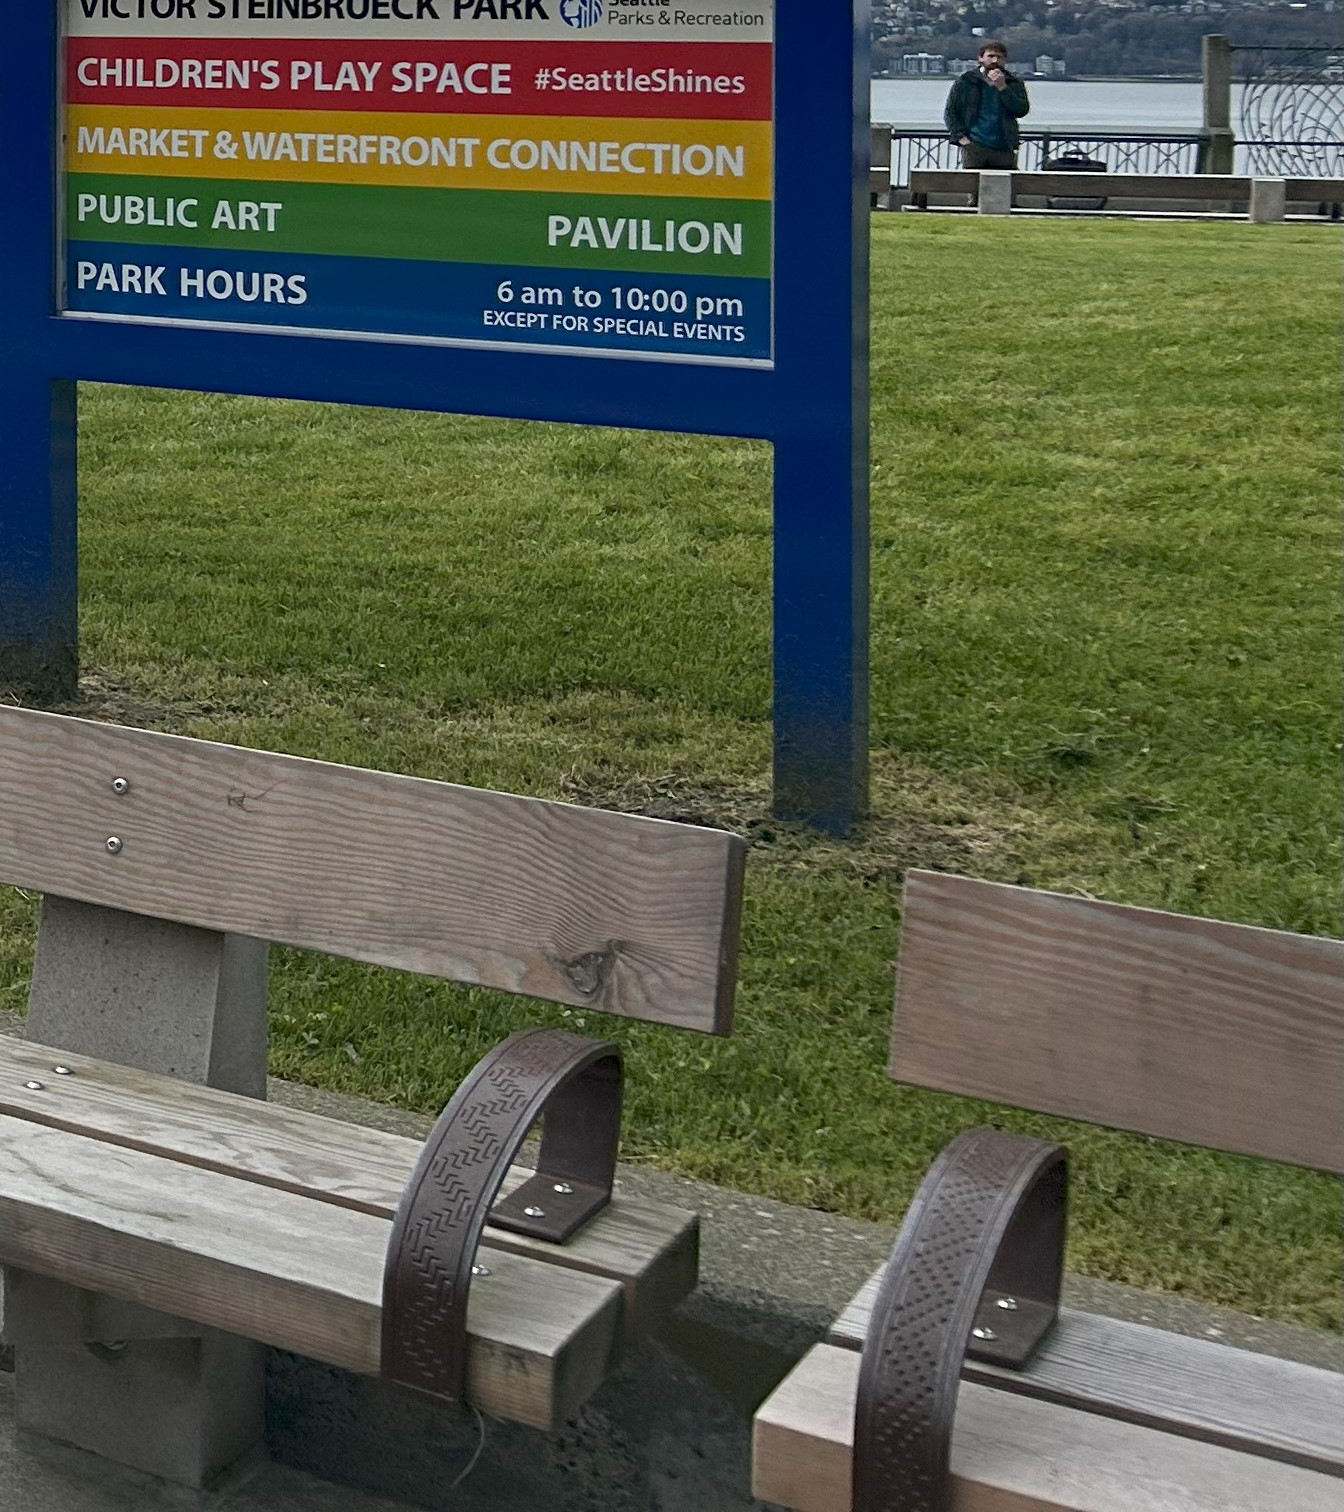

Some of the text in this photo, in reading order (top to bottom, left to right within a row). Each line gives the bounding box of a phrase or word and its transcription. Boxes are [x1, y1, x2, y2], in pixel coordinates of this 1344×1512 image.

[608, 10, 764, 26] Parks & Recreation
[77, 57, 512, 94] CHILDREN'S PLAY SPACE
[534, 67, 746, 94] #SeattleShines
[77, 126, 744, 177] MARKET & WATERFRONT CONNECTION
[78, 193, 282, 232] PUBLIC ART
[548, 215, 742, 256] PAVILION
[77, 261, 308, 305] PARK HOURS
[497, 280, 743, 320] 6 am to 10:00 pm
[483, 310, 745, 342] EXCEPT FOR SPECIAL EVENTS
